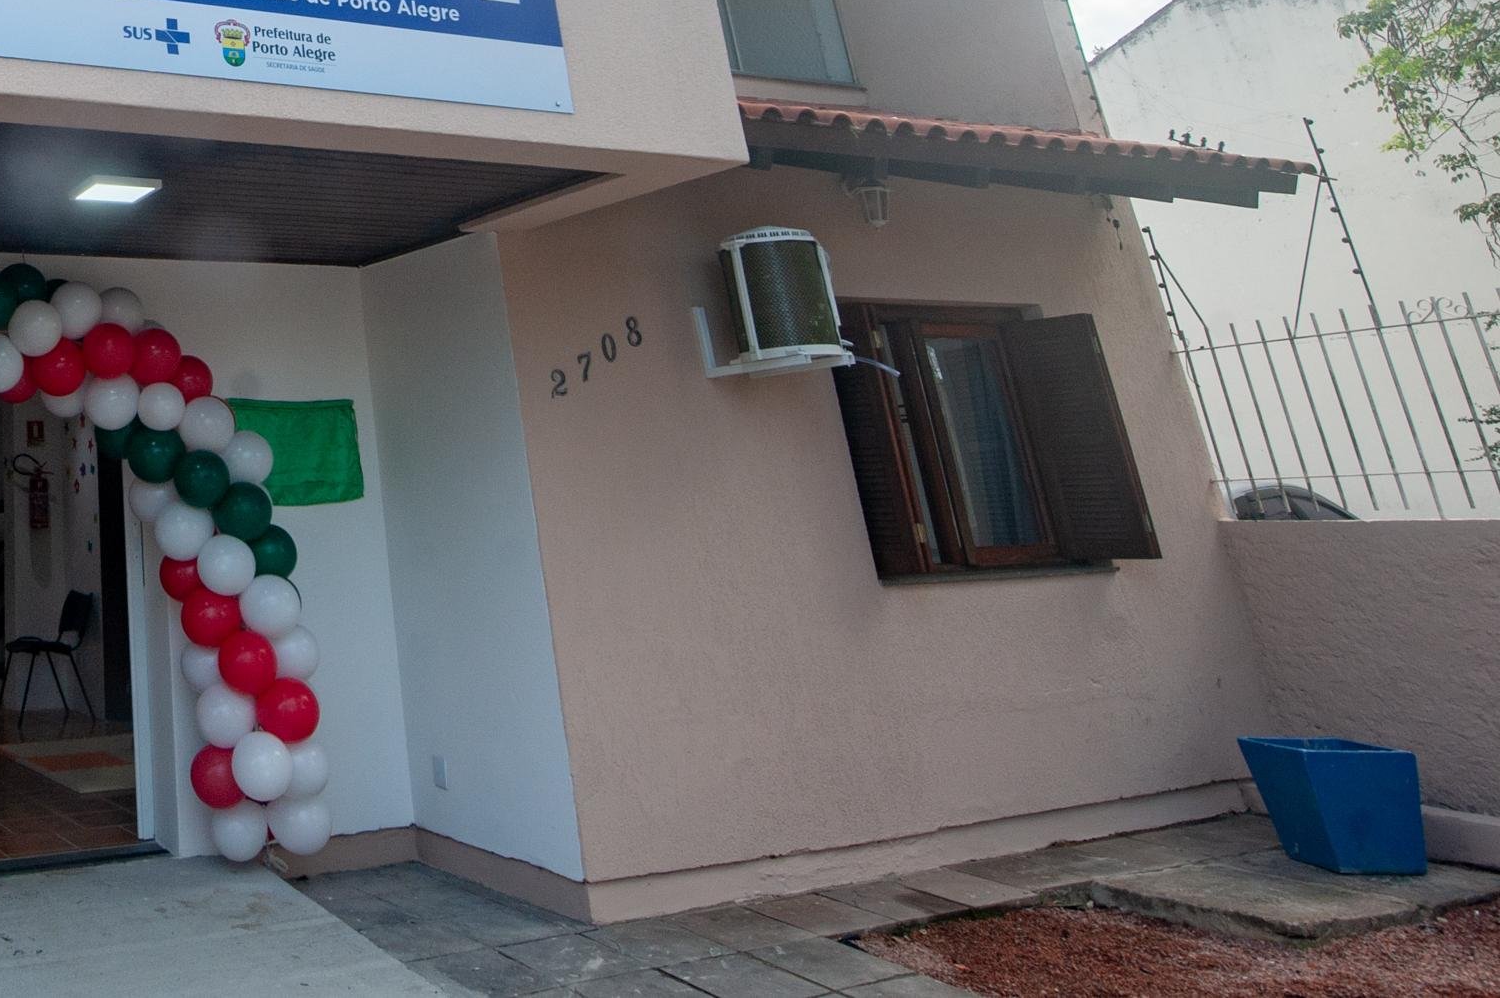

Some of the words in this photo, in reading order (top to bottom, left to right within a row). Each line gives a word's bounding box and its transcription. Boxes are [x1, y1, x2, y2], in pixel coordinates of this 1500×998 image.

[397, 0, 460, 22] Alegre
[123, 25, 153, 41] SUS
[253, 26, 313, 43] Prefeitura
[316, 32, 332, 45] de
[252, 41, 288, 56] Porto
[292, 45, 336, 62] Alegre
[551, 316, 642, 398] 2708
